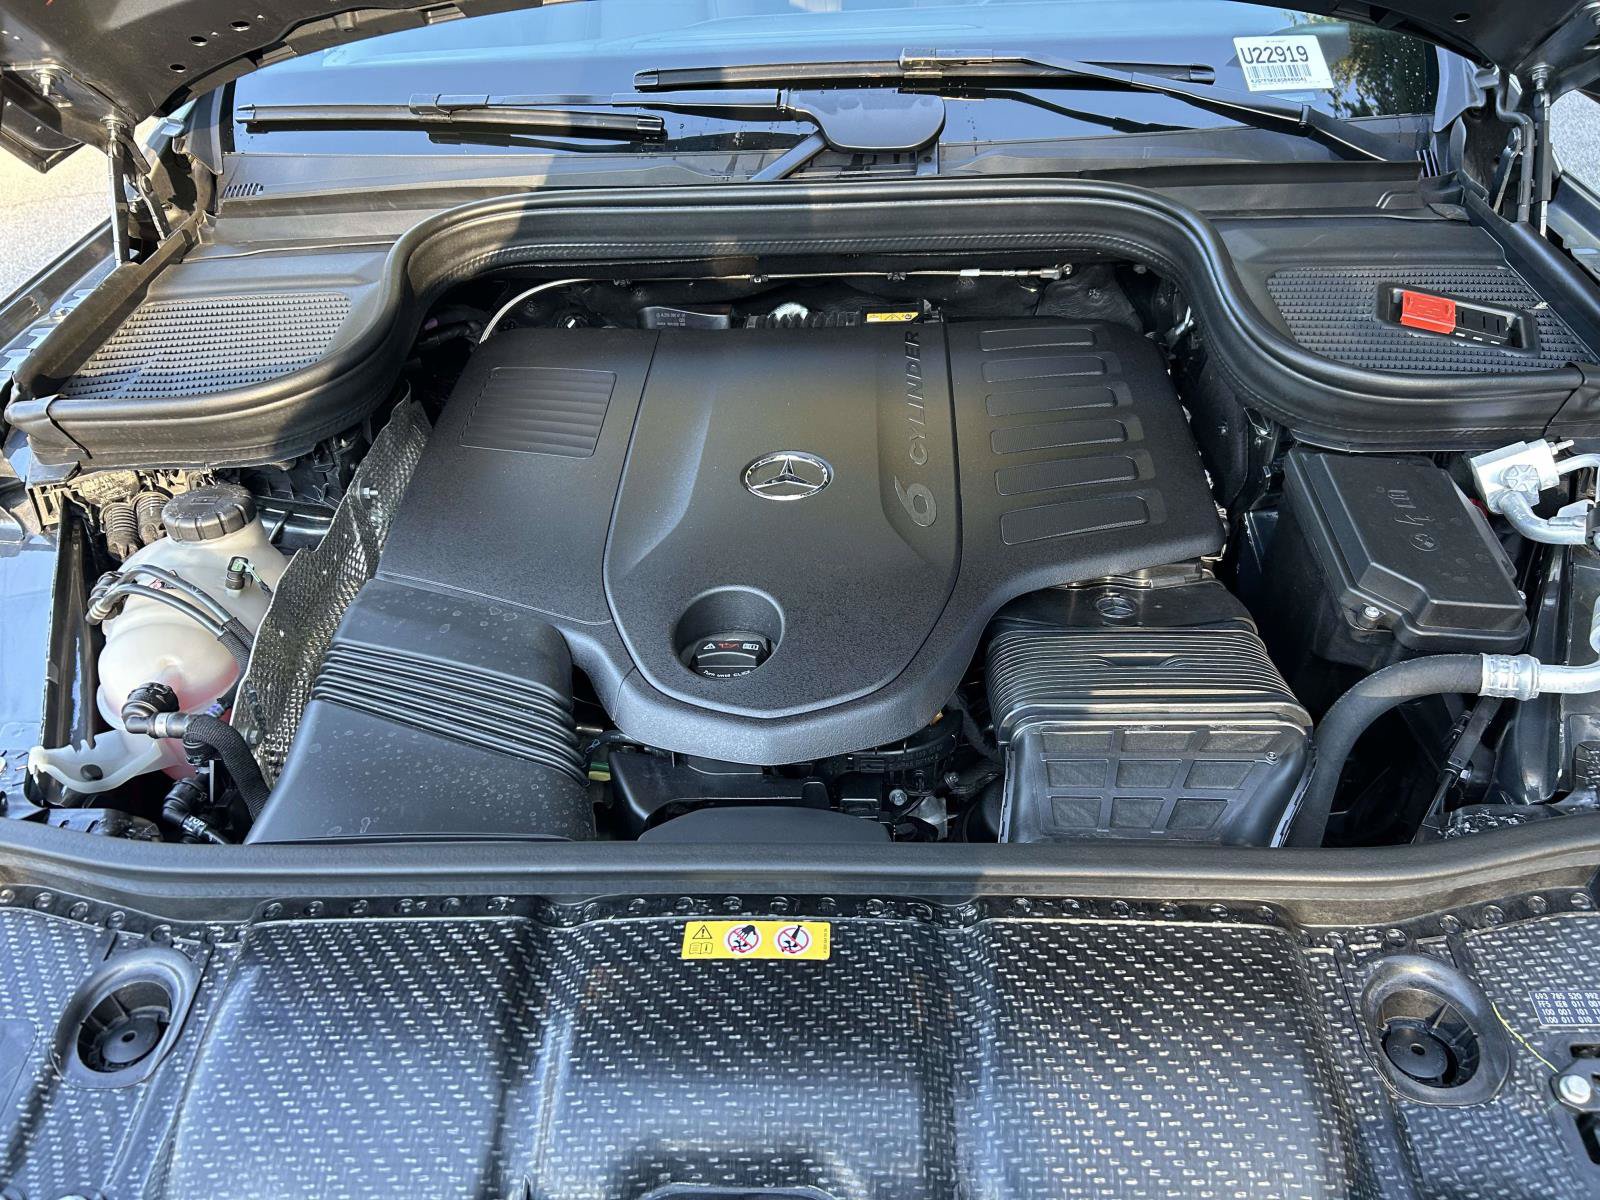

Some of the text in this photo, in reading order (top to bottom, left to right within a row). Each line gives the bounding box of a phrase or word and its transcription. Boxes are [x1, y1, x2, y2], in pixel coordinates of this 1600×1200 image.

[1240, 45, 1309, 64] U22919
[894, 330, 937, 527] 6 CYLINDER
[1571, 1000, 1585, 1008] 011
[1541, 1008, 1555, 1016] 100
[1557, 1008, 1572, 1016] 001
[1575, 1008, 1589, 1016] 101
[1544, 1016, 1558, 1024] 100
[1560, 1016, 1575, 1024] 011
[1577, 1016, 1593, 1024] 010
